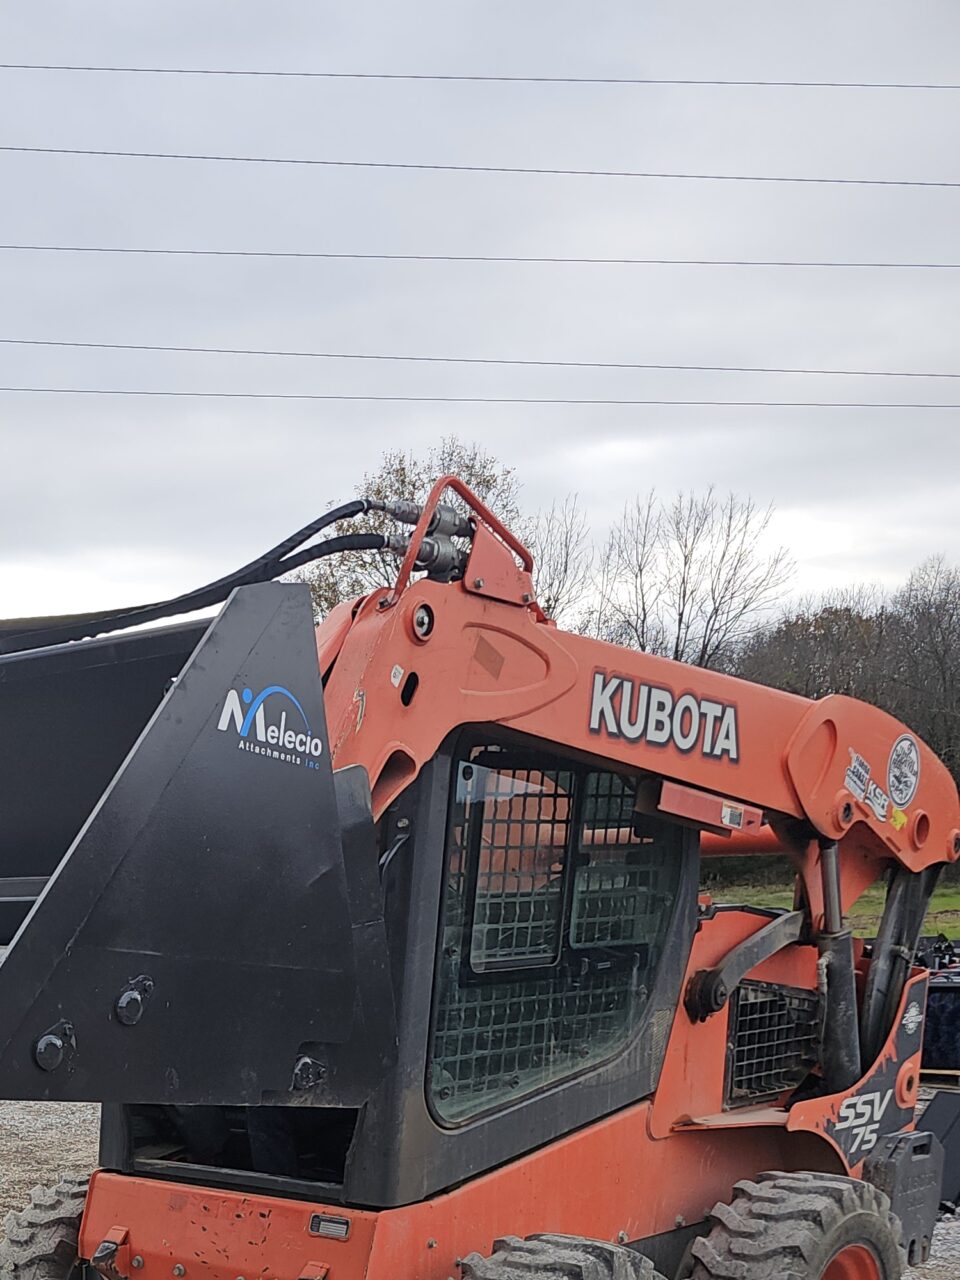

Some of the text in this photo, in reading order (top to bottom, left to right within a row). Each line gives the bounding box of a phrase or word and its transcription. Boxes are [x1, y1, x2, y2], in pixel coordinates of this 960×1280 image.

[217, 685, 323, 757] Melecio
[589, 672, 739, 762] KUBOTA
[238, 740, 320, 770] Attachments Inc
[834, 1089, 894, 1131] SSV
[849, 1123, 880, 1153] 75
